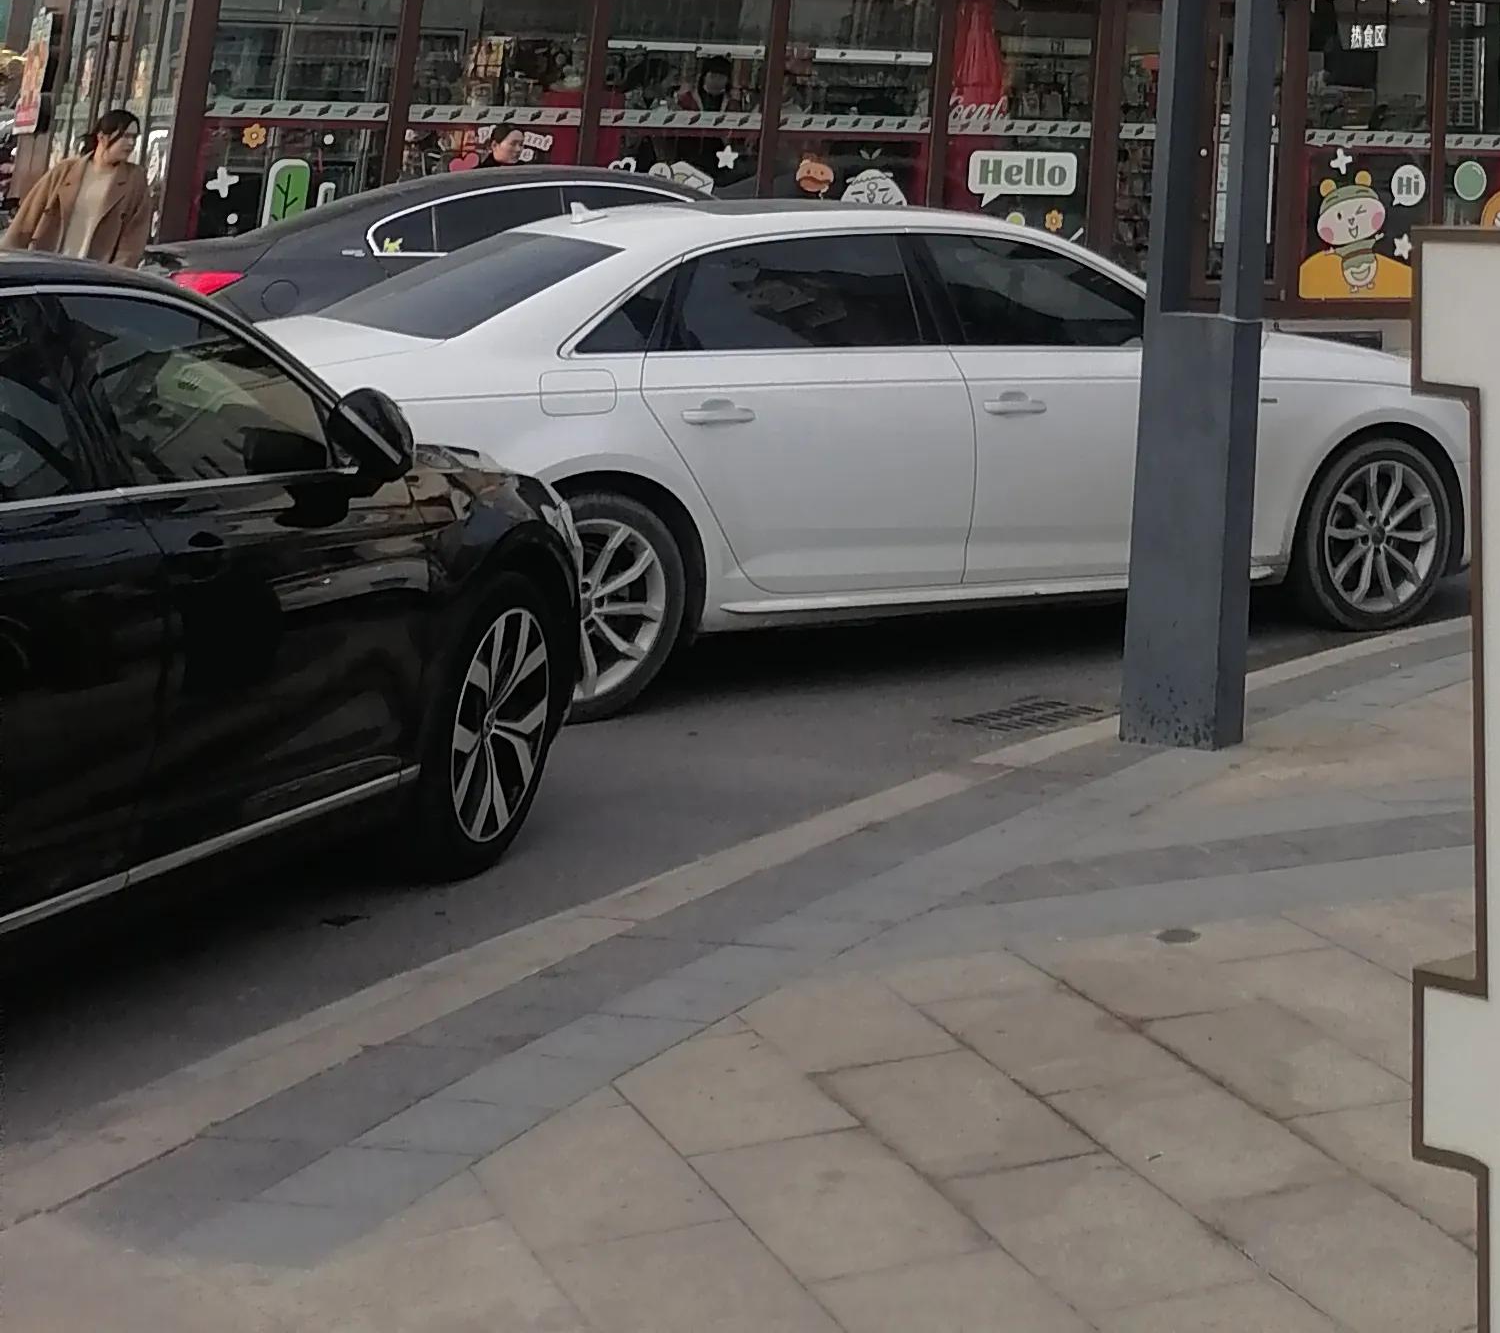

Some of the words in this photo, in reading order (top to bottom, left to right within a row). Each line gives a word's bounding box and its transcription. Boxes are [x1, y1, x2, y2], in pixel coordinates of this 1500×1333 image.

[1350, 24, 1387, 49] 热食区
[979, 158, 1067, 186] Hello
[1397, 174, 1420, 196] Hi
